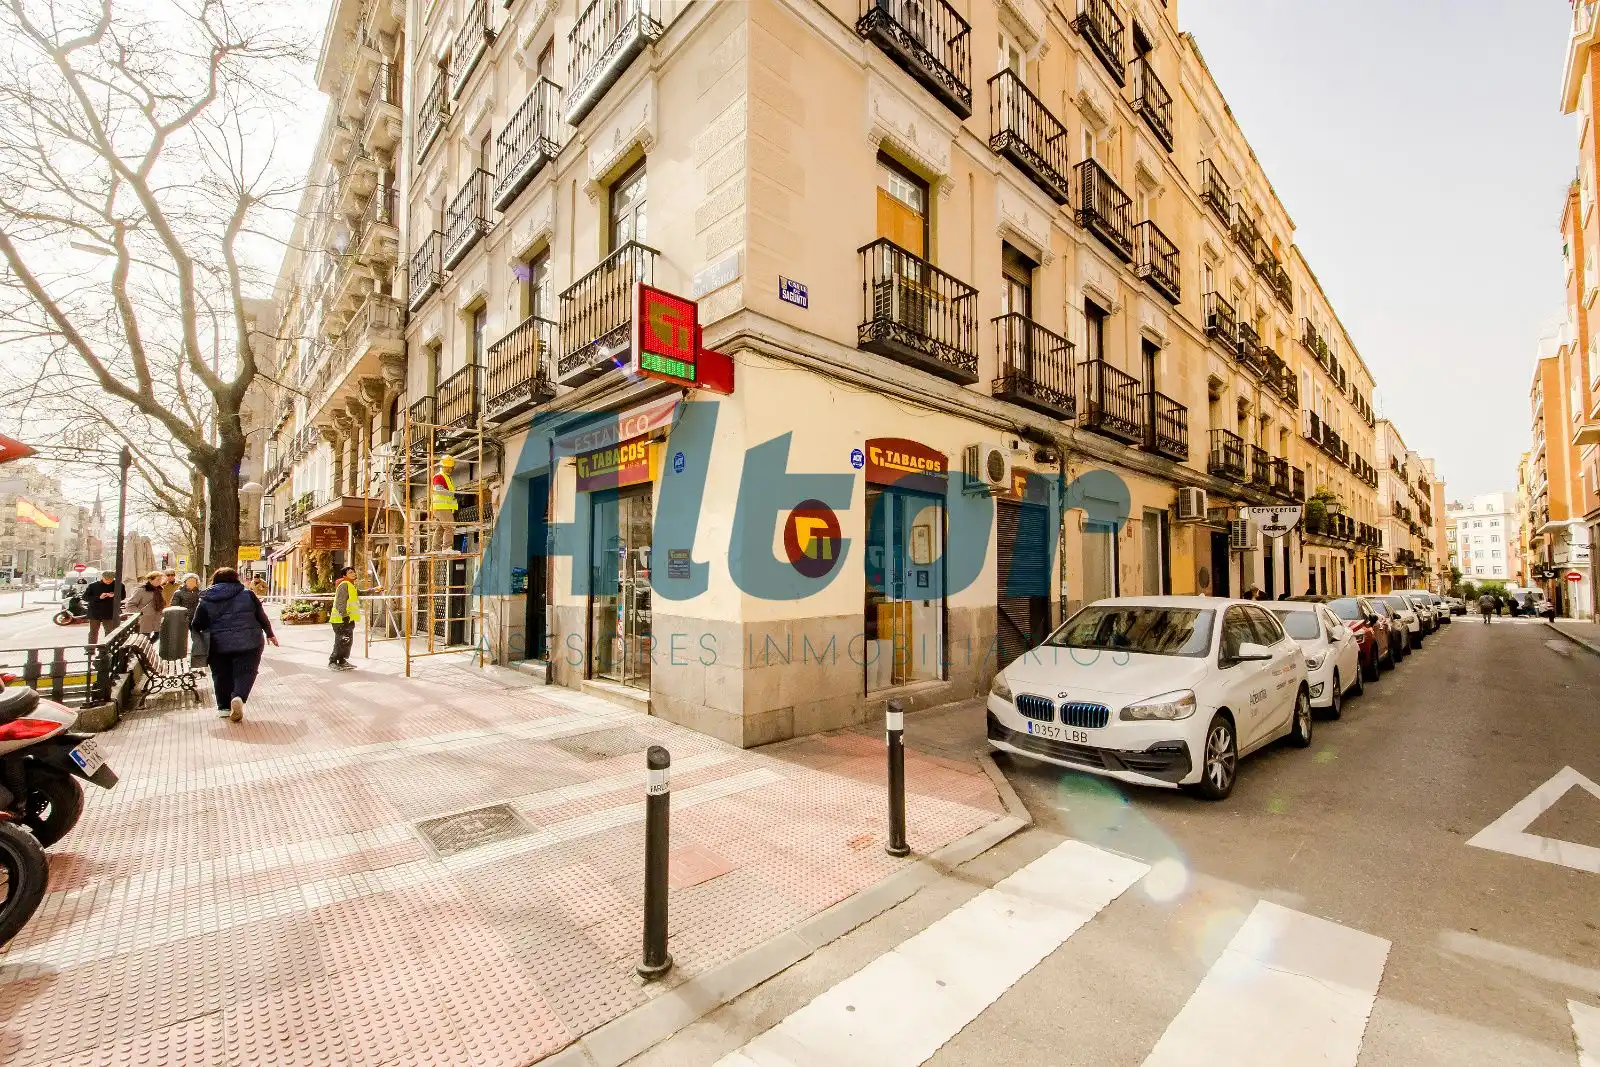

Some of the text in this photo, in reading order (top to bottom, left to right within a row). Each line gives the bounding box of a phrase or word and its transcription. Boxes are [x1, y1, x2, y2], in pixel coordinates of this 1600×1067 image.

[782, 289, 807, 307] SAGUNTO
[574, 414, 649, 451] ESTANCO
[592, 440, 645, 470] TABACOS
[886, 450, 941, 472] TABACOS
[1034, 723, 1087, 743] 0357 LBB
